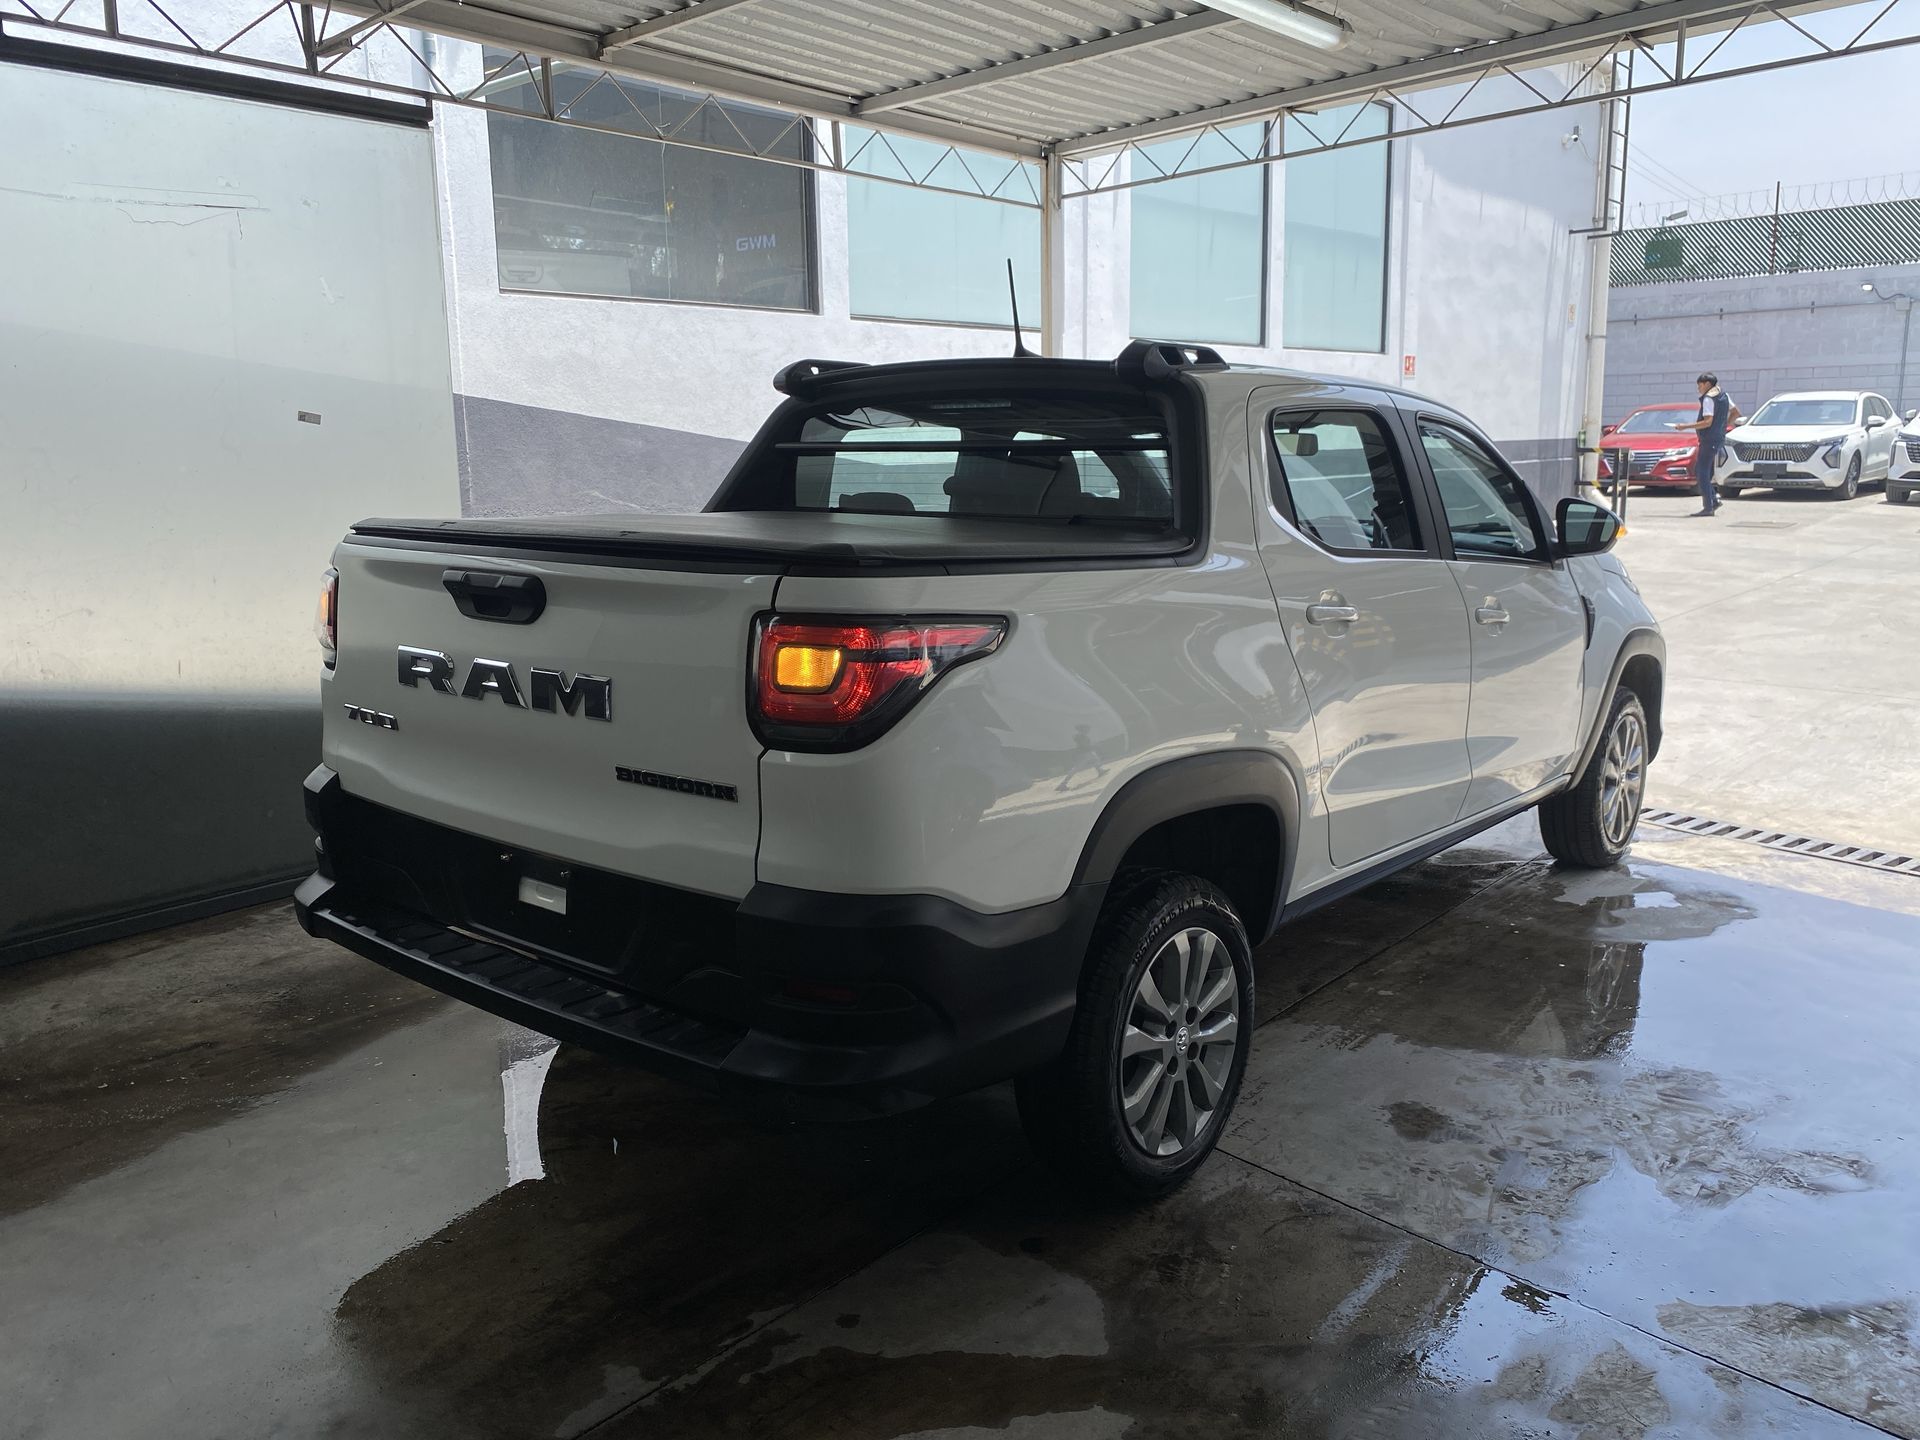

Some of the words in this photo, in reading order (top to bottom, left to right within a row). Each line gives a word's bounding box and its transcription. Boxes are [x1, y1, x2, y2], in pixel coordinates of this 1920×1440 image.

[736, 233, 776, 251] GWM
[397, 645, 612, 722] RAM
[342, 702, 399, 731] 700
[614, 763, 739, 802] BIGHORN
